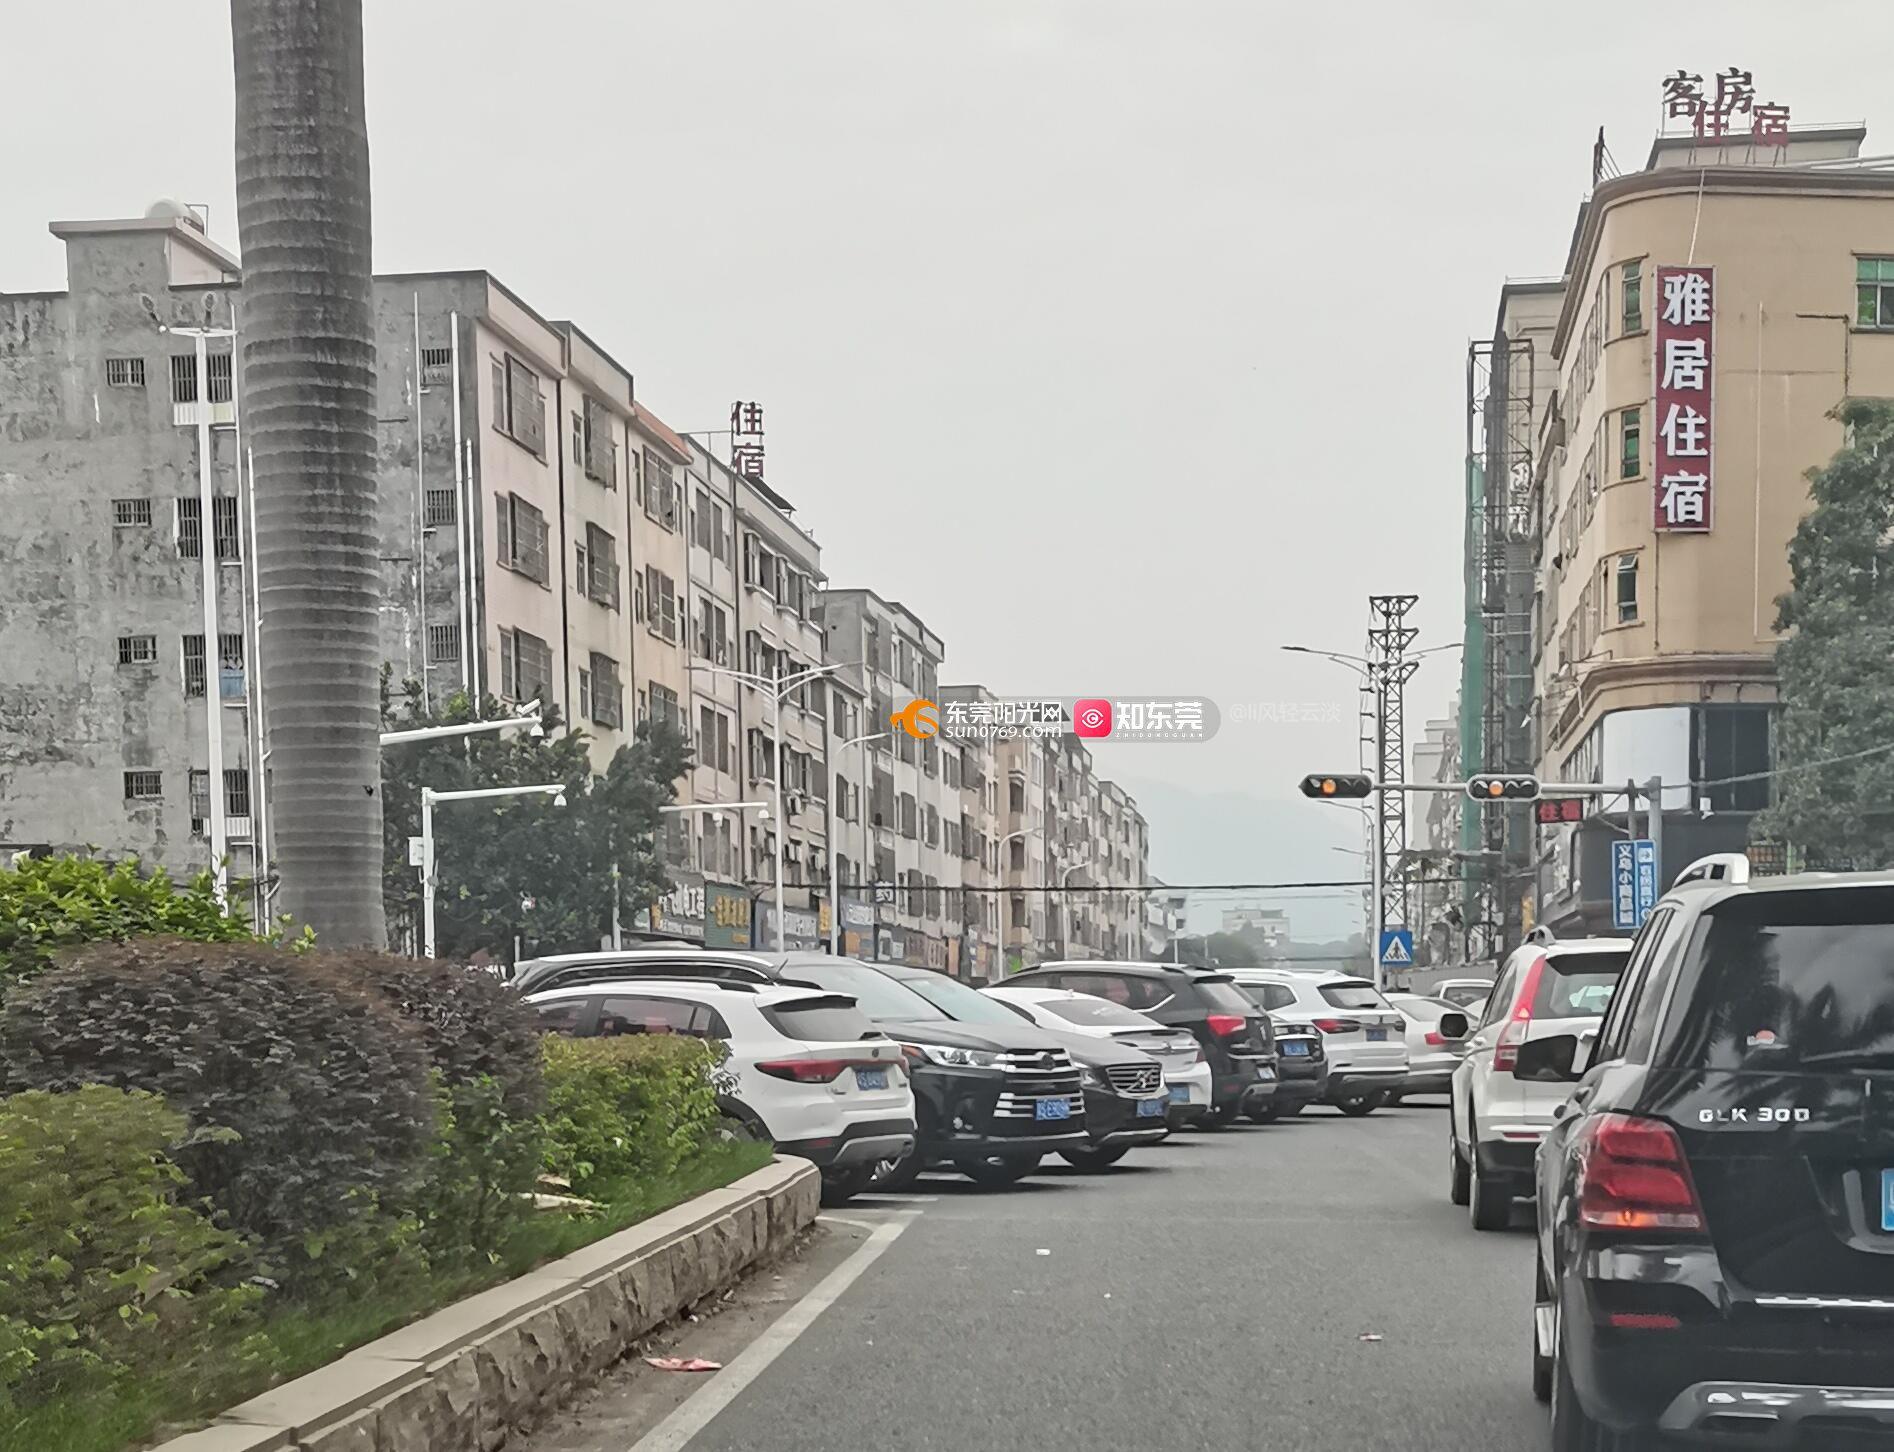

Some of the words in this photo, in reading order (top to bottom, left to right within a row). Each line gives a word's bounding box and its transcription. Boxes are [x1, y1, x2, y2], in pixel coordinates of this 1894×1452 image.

[1662, 67, 1756, 118] 客房
[1692, 101, 1790, 146] 住宿
[1660, 272, 1712, 525] 雅居住宿
[730, 400, 766, 477] 住宿
[1618, 844, 1633, 924] 义乌小
[1698, 1107, 1748, 1123] GLK
[1757, 1107, 1810, 1122] 300
